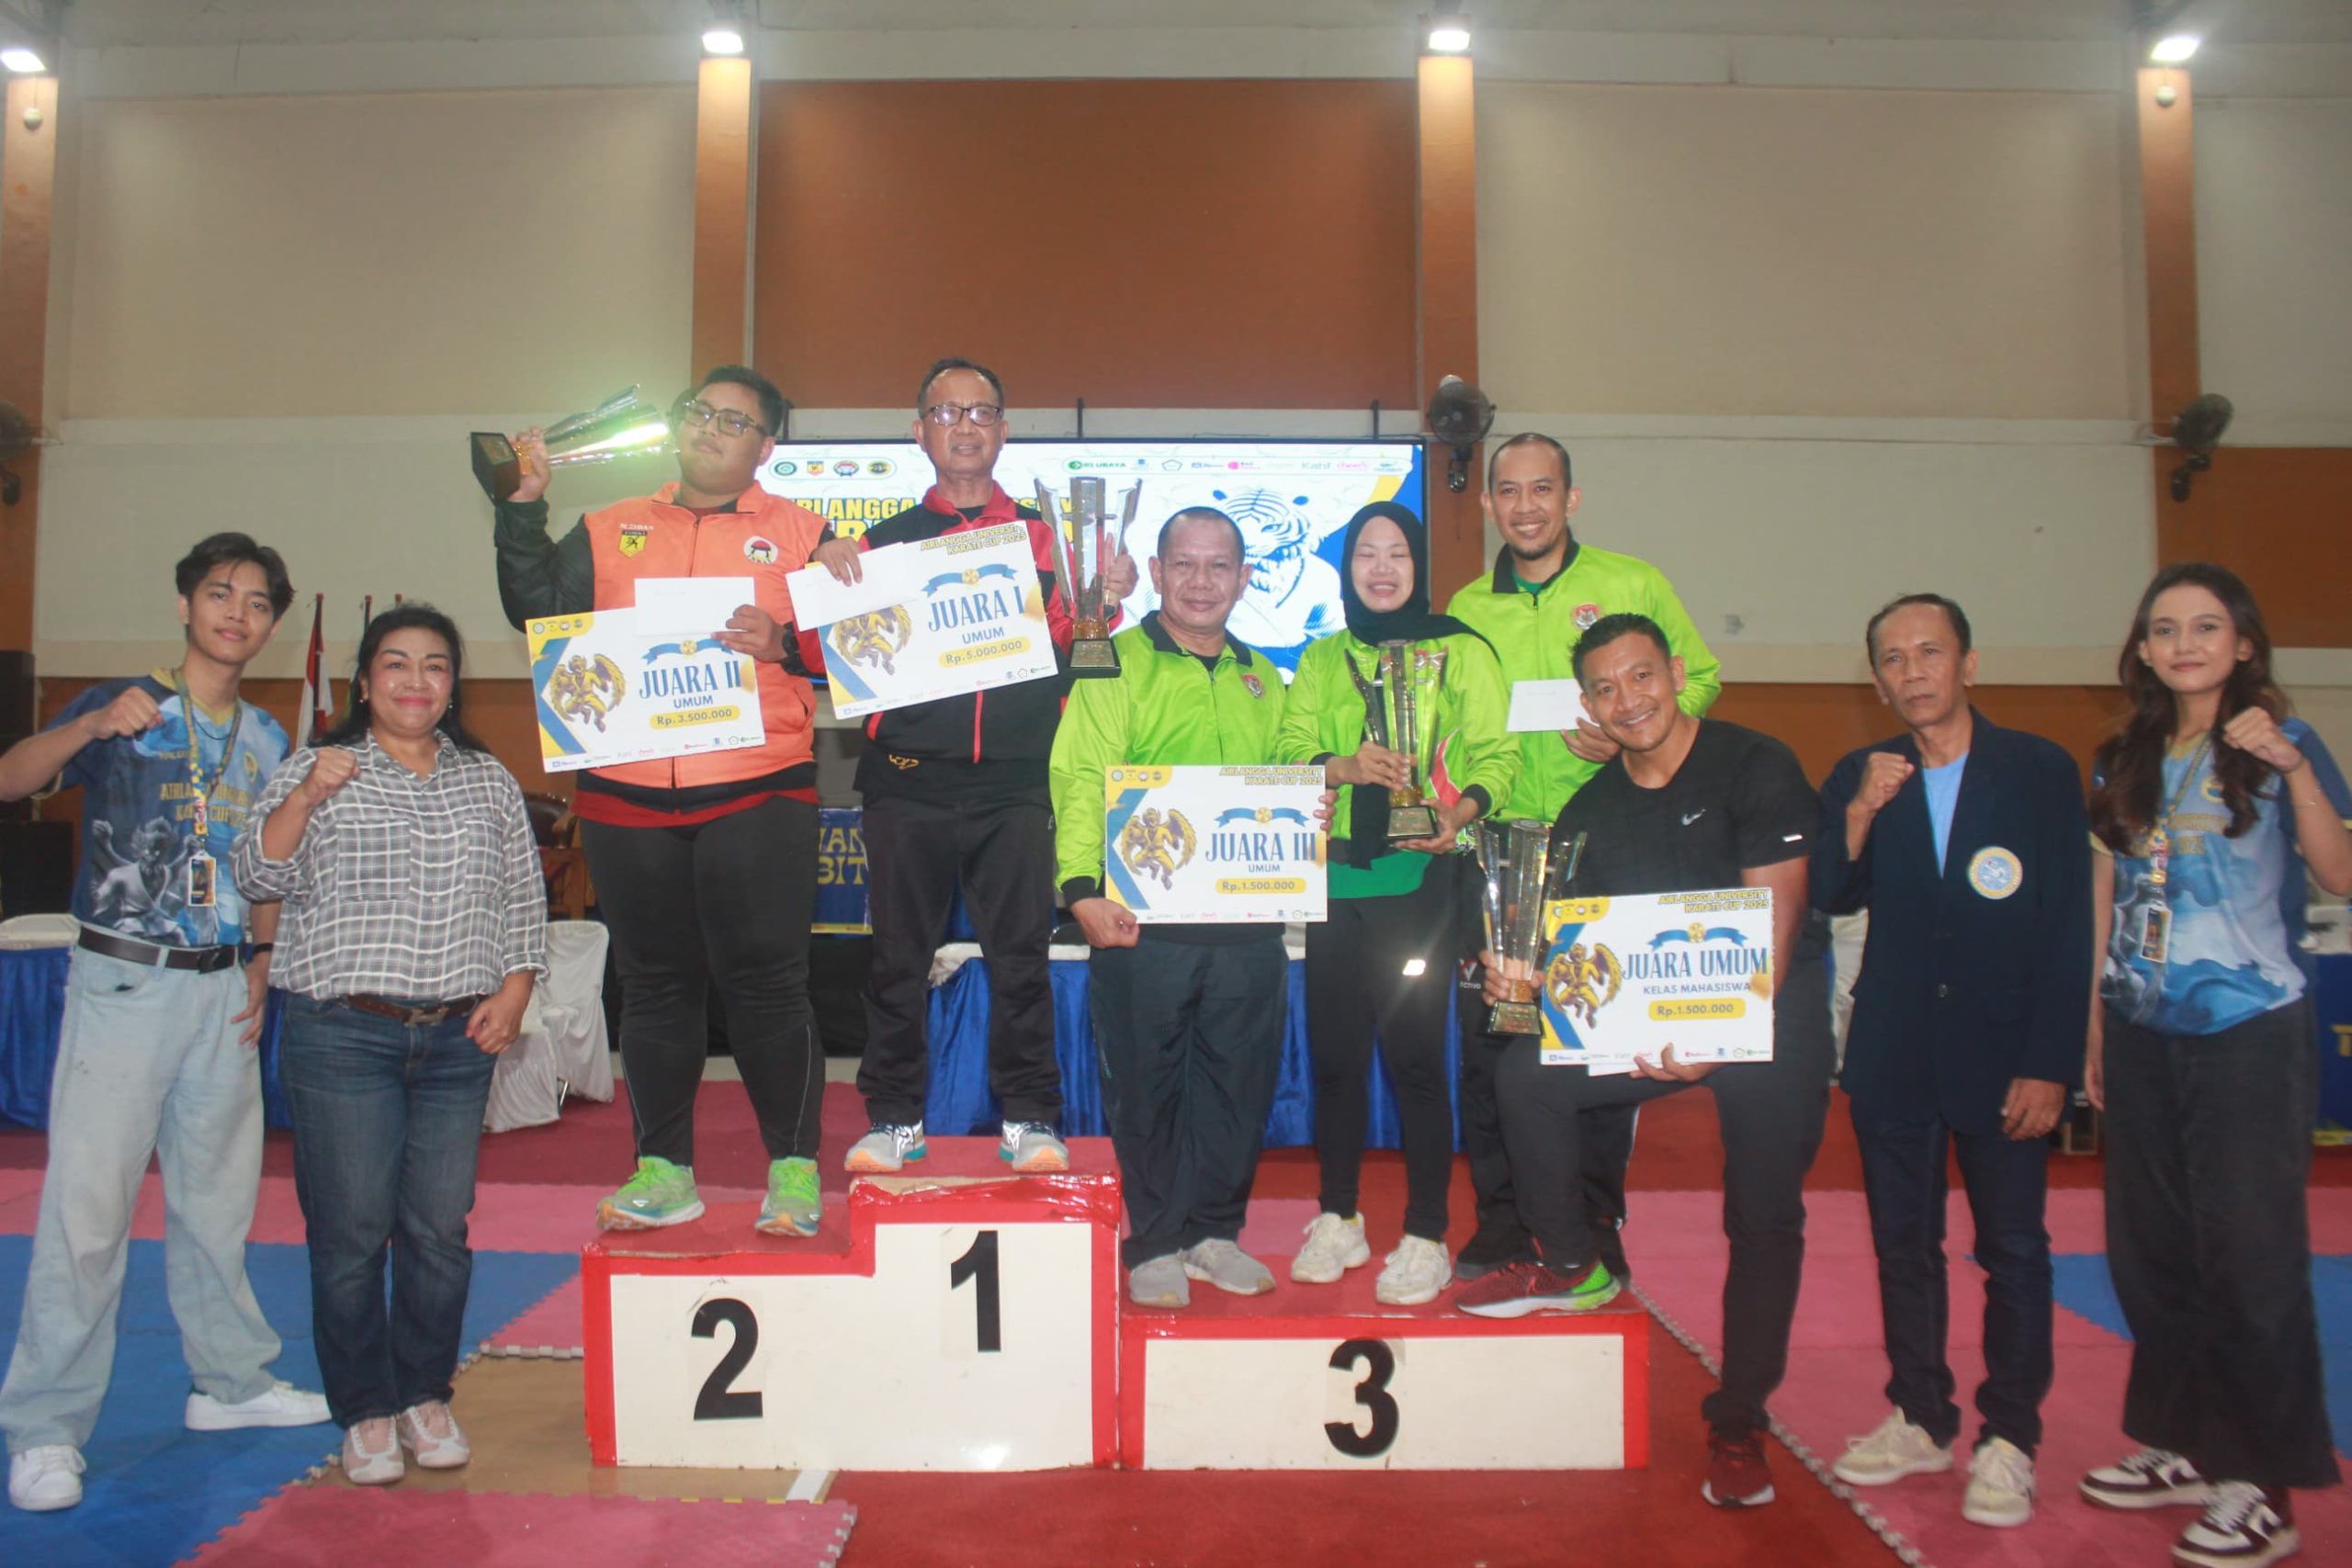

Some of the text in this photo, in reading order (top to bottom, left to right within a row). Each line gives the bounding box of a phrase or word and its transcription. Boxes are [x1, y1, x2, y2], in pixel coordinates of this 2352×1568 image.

[920, 533, 974, 551] AIRLANGGA
[946, 533, 1027, 556] KARATE CUP 2025
[928, 585, 1025, 632] JUARA I
[962, 626, 1005, 645] UMUM
[639, 660, 741, 699] JUARA II
[673, 695, 713, 708] UMUM
[1219, 767, 1323, 776] AIRLANGGA UNIVERSITY
[1244, 776, 1280, 785] KARATE
[1280, 776, 1298, 785] CUP
[1205, 832, 1316, 862] JUARA III
[1249, 863, 1280, 873] UMUM
[1658, 889, 1768, 905] AIRLANGGA UNIVERSITY
[1684, 900, 1769, 913] KARATE CUP 2025
[1623, 948, 1768, 980] JUARA UMUM
[1644, 983, 1751, 995] KELAS MAHASISWA
[951, 1231, 1001, 1351] 1
[692, 1299, 763, 1420] 2
[1325, 1338, 1400, 1458] 3
